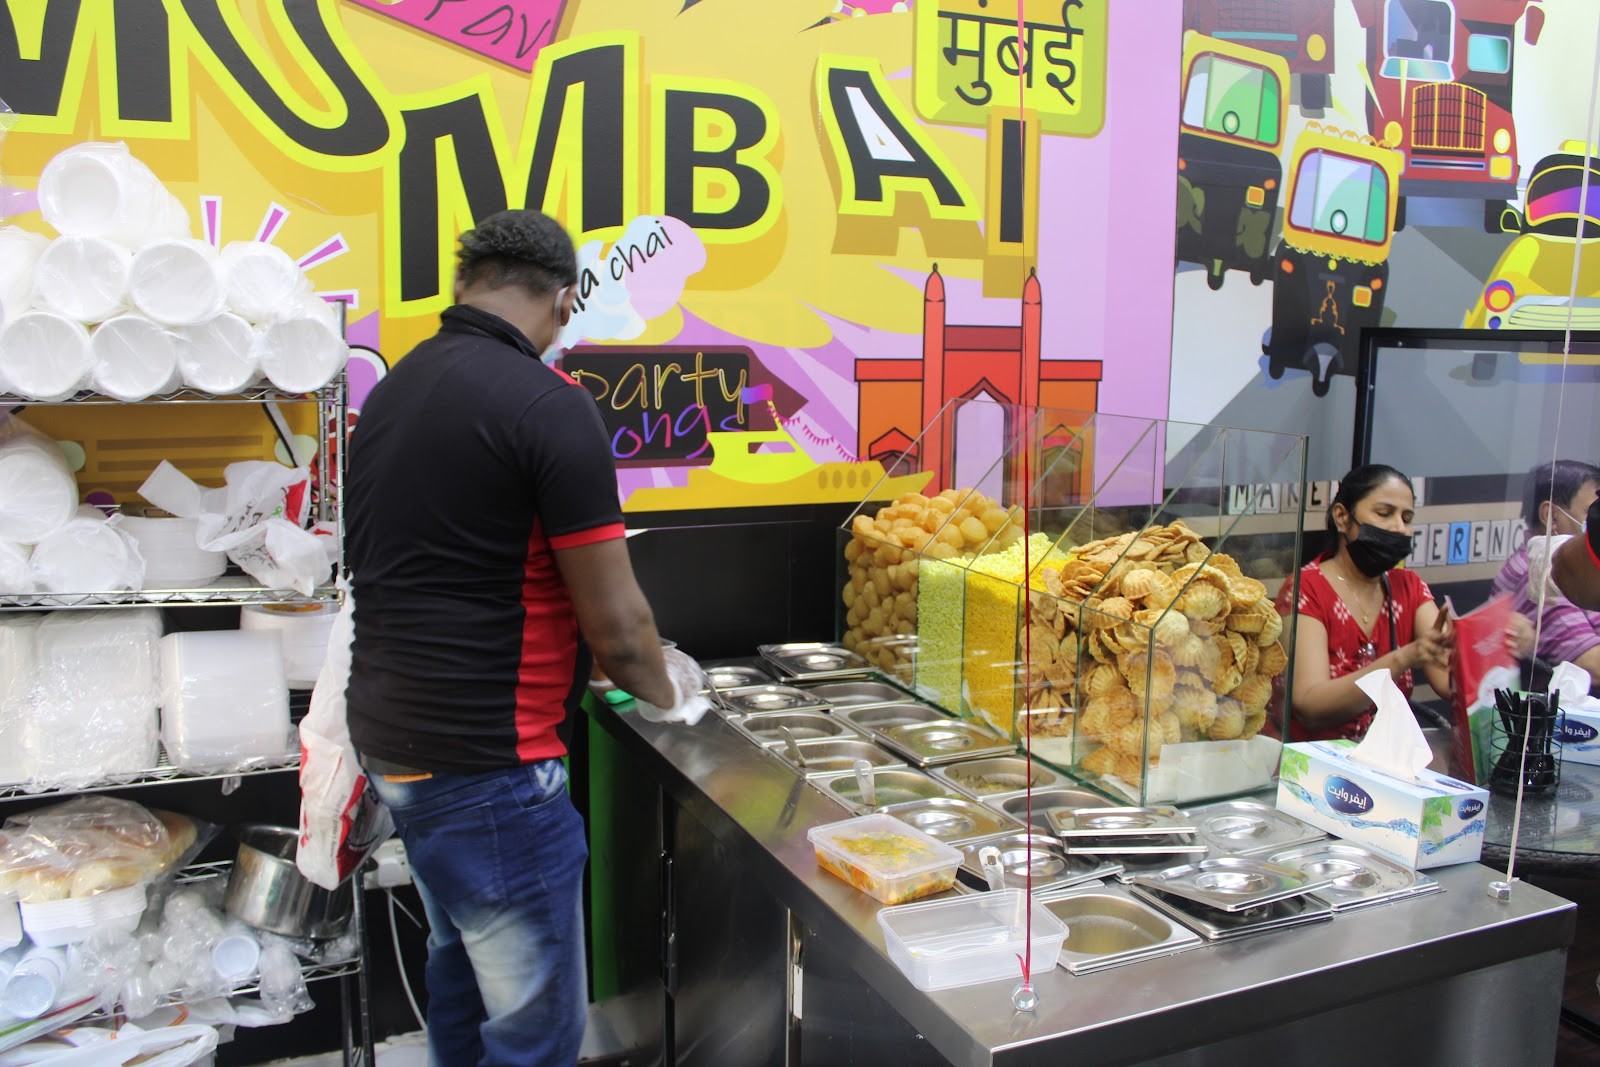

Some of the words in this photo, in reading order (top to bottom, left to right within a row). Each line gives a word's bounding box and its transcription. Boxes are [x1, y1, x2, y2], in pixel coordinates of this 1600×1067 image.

[422, 0, 552, 59] av
[937, 0, 1085, 106] मुंबई
[610, 219, 673, 281] chai
[571, 351, 747, 425] party
[611, 403, 746, 460] ongs
[1327, 785, 1349, 802] وايت
[1348, 793, 1367, 810] إيفر
